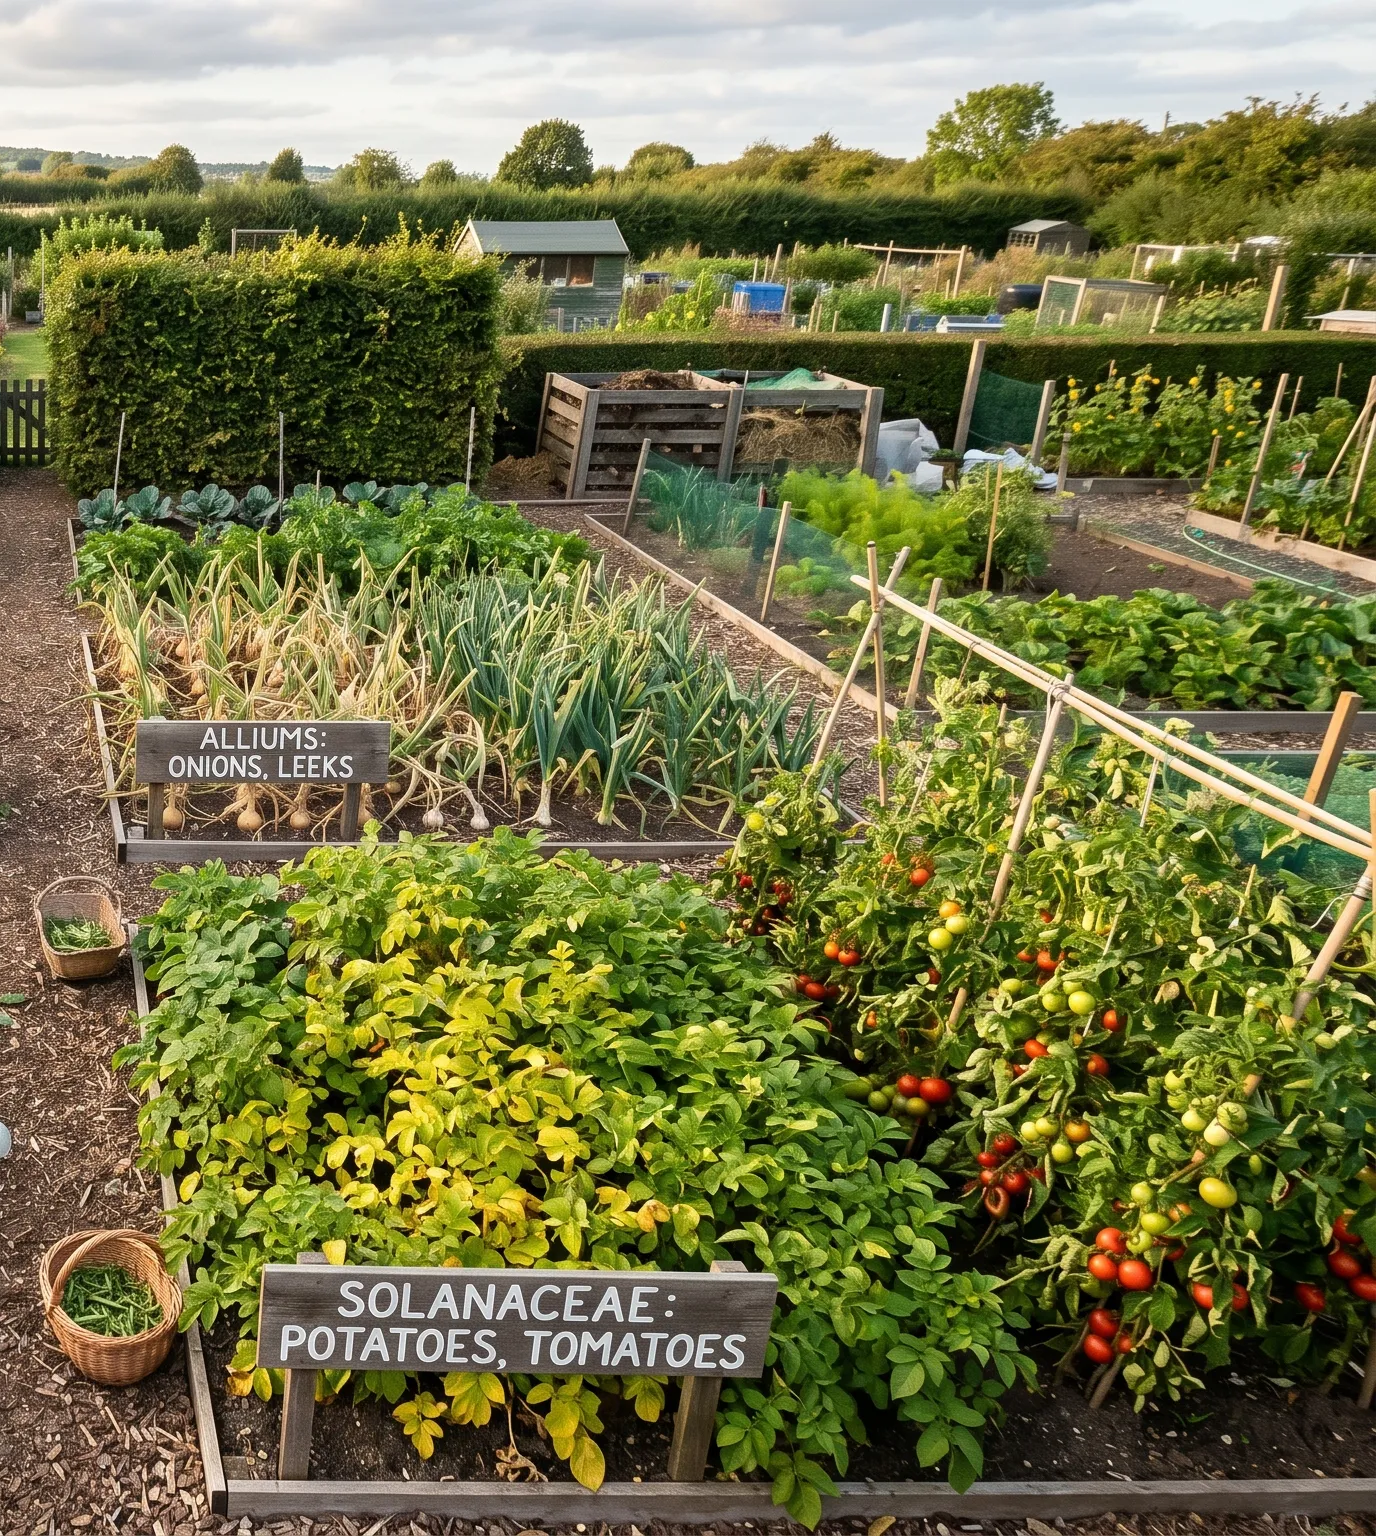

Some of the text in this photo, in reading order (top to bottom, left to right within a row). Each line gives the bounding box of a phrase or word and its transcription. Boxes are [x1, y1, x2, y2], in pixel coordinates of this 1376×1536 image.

[199, 726, 327, 751] ALLIUMS:
[168, 754, 354, 781] ONIONS, LEEKS
[337, 1280, 677, 1323] SOLANACEAE:
[279, 1324, 747, 1370] POTATOES, TOMATOES
